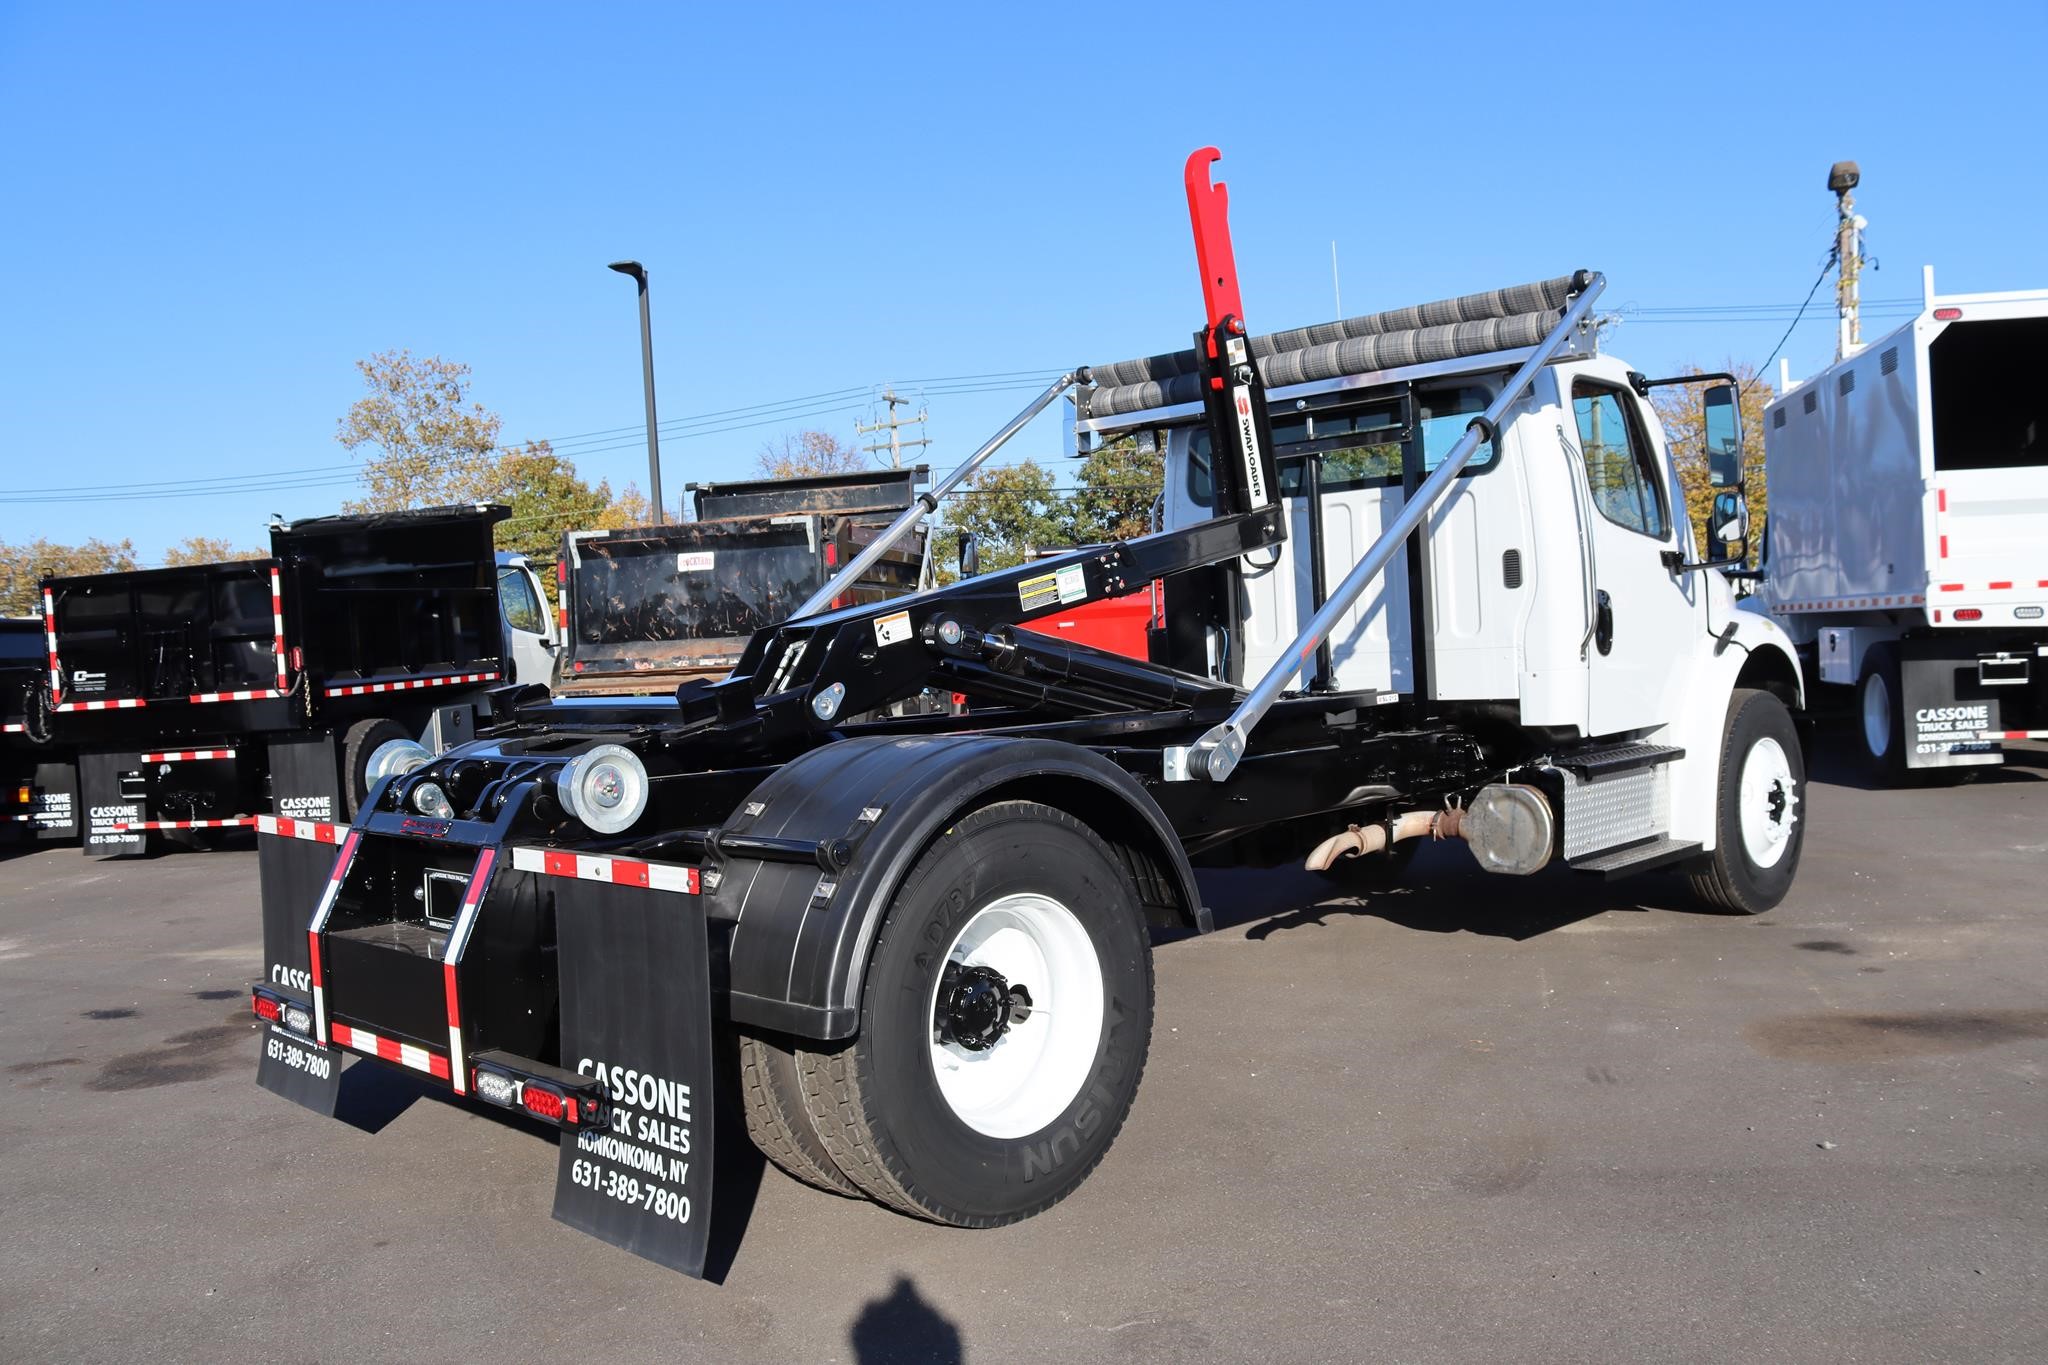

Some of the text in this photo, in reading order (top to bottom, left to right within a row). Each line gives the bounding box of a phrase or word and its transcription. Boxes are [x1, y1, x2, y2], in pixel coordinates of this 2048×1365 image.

[1242, 418, 1261, 498] SWAPLOADER
[1916, 706, 1988, 722] CASSONE
[1917, 720, 1988, 732] TRUCK SALES
[280, 796, 331, 809] CASSONE
[90, 805, 138, 818] CASSONE
[281, 808, 331, 817] TRUCK SALES
[91, 818, 114, 826] TRUCK
[90, 834, 140, 844] 631-389-7800
[267, 1038, 330, 1080] 631-389-7800
[637, 1115, 690, 1154] SALES
[577, 1130, 689, 1185] RONKONKOMA, NY
[571, 1158, 691, 1224] 631-389-7800
